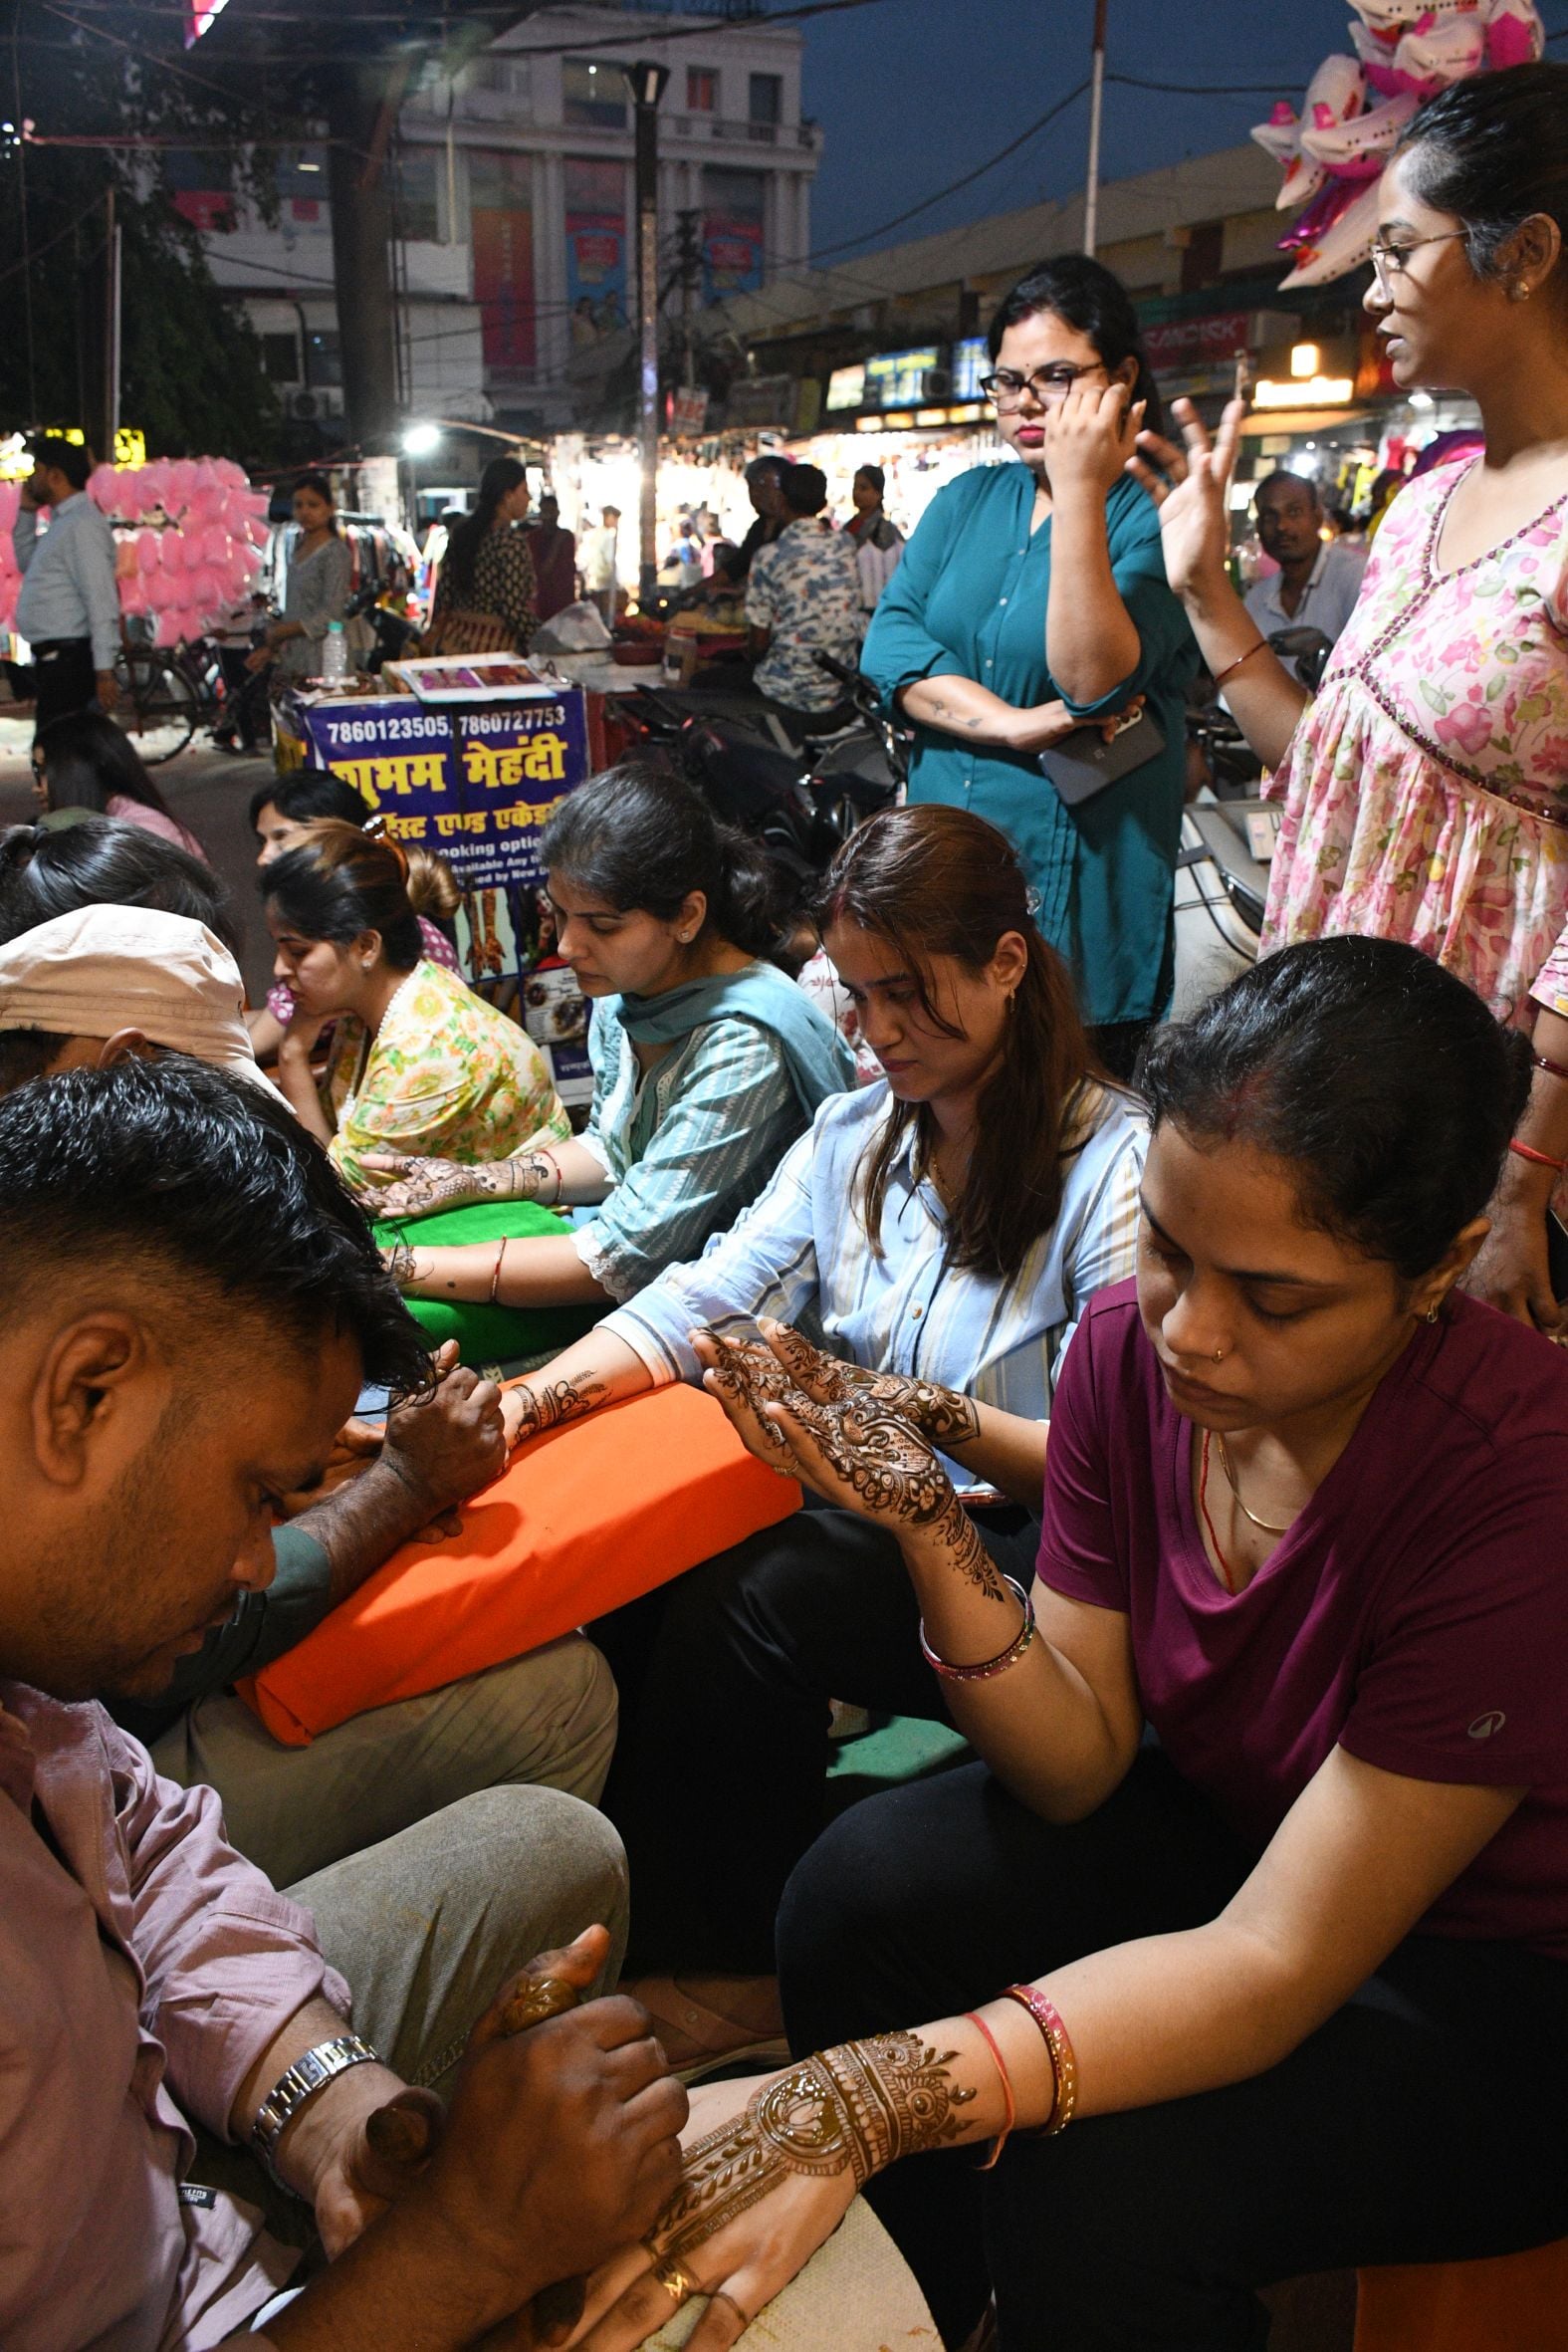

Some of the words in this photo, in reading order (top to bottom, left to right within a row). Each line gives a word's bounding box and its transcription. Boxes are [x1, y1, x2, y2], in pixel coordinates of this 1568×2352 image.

[327, 716, 454, 744] 7860123505,
[459, 705, 565, 736] 7860727753
[462, 732, 568, 788] मेहंदी
[433, 812, 488, 836] एण्ड
[437, 843, 496, 858] ooking
[500, 835, 544, 853] optio
